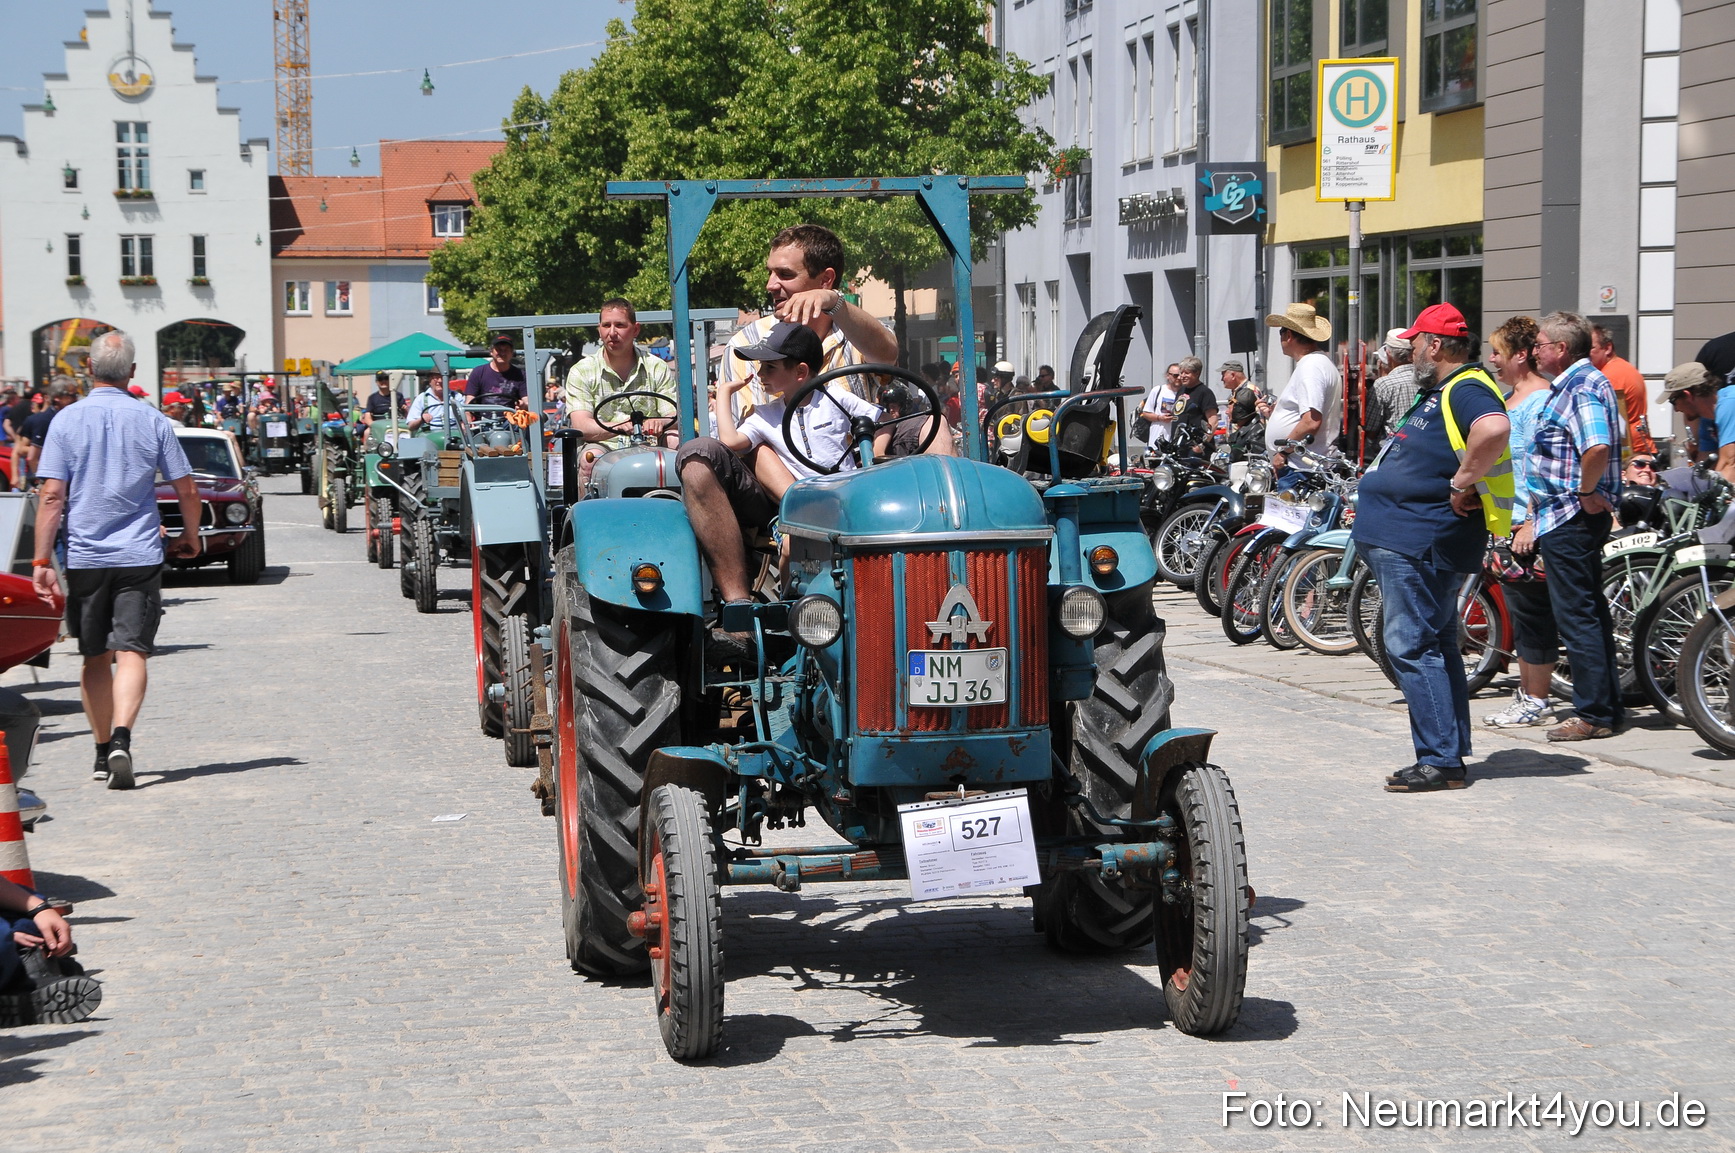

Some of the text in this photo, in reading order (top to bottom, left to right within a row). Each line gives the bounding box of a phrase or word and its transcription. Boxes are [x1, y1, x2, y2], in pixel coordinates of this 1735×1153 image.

[1346, 82, 1369, 115] H
[1337, 136, 1376, 144] Rathaus
[1221, 181, 1247, 212] G2
[1611, 535, 1651, 551] SL 102
[929, 656, 962, 678] NM
[926, 679, 992, 703] JJ 36
[961, 816, 1002, 840] 527
